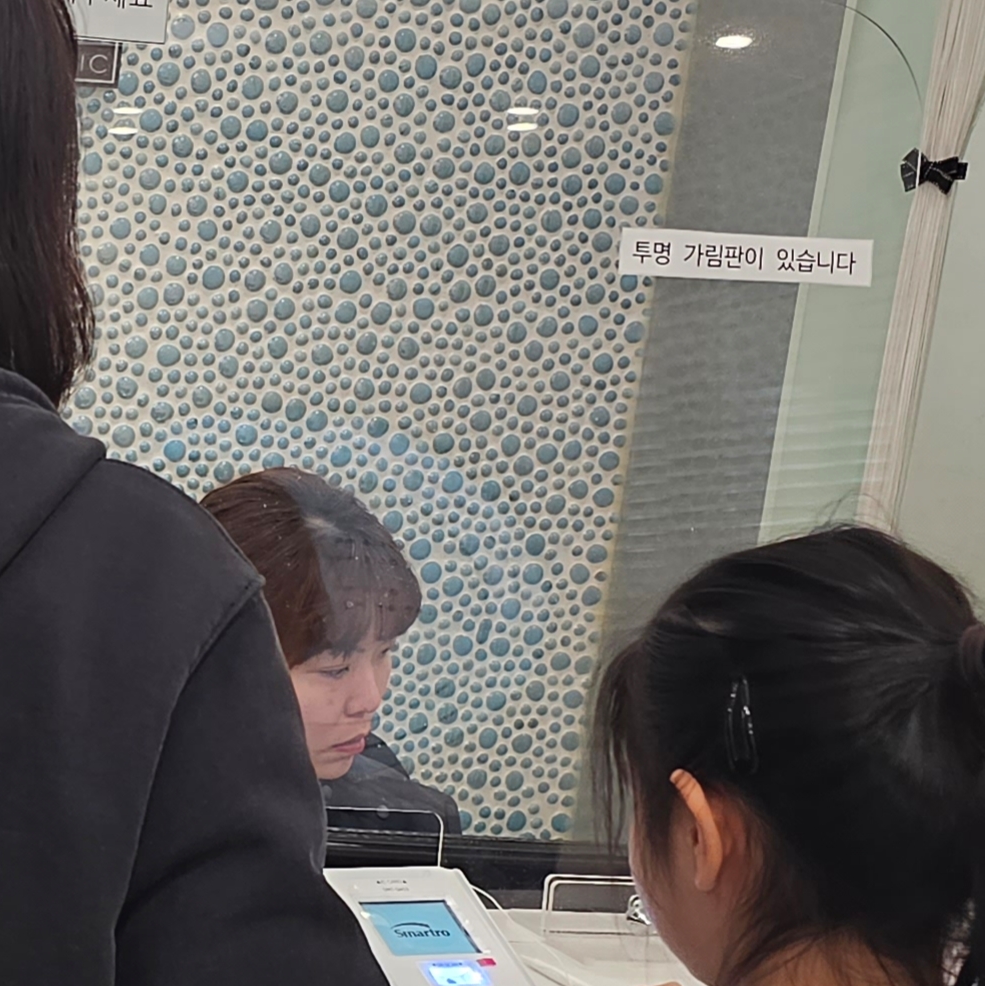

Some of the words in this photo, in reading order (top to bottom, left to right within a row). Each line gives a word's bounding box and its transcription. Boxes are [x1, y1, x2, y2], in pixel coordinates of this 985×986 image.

[632, 241, 672, 265] 투명
[684, 243, 764, 270] 가림판이
[777, 248, 857, 275] 있습니다
[394, 926, 451, 939] Smartro
